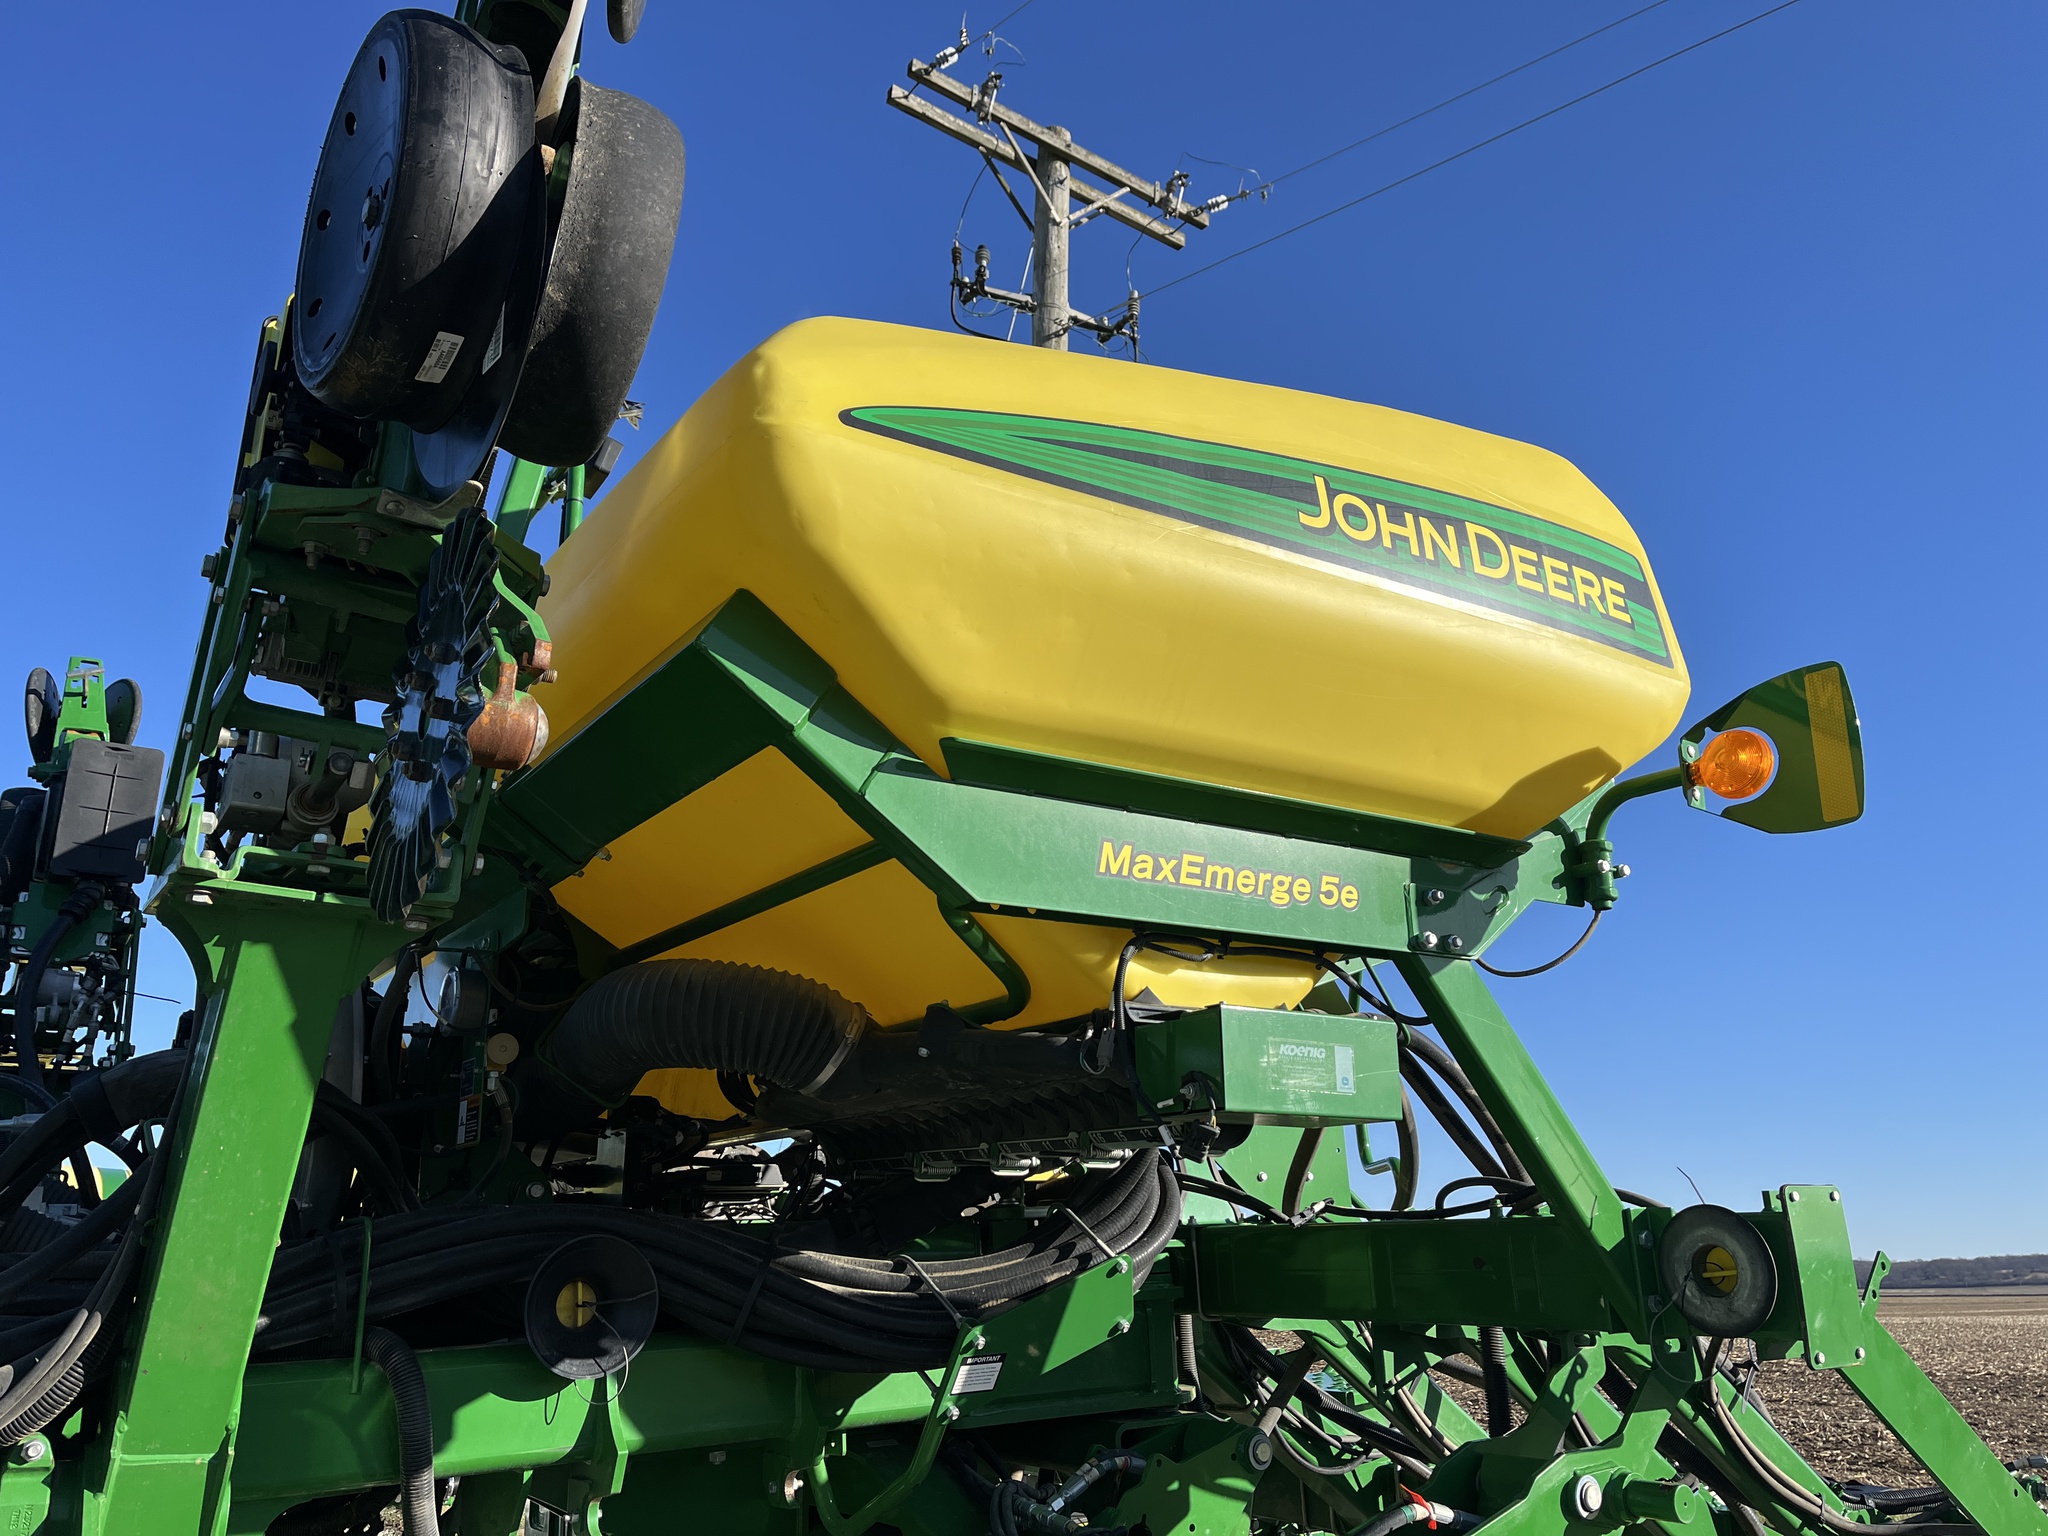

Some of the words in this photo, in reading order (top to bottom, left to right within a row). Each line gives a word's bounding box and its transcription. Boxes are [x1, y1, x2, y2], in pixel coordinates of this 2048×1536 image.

[1298, 474, 1462, 569] JOHN
[1464, 521, 1633, 626] DEERE
[1097, 840, 1312, 907] MaxEmerge
[1318, 874, 1360, 909] 5e
[1092, 1132, 1106, 1144] 16
[1114, 1130, 1128, 1142] 15
[1019, 1142, 1032, 1153] 10
[1042, 1140, 1055, 1151] 11
[1064, 1139, 1079, 1150] 12
[966, 1355, 1001, 1364] IMPORTANT
